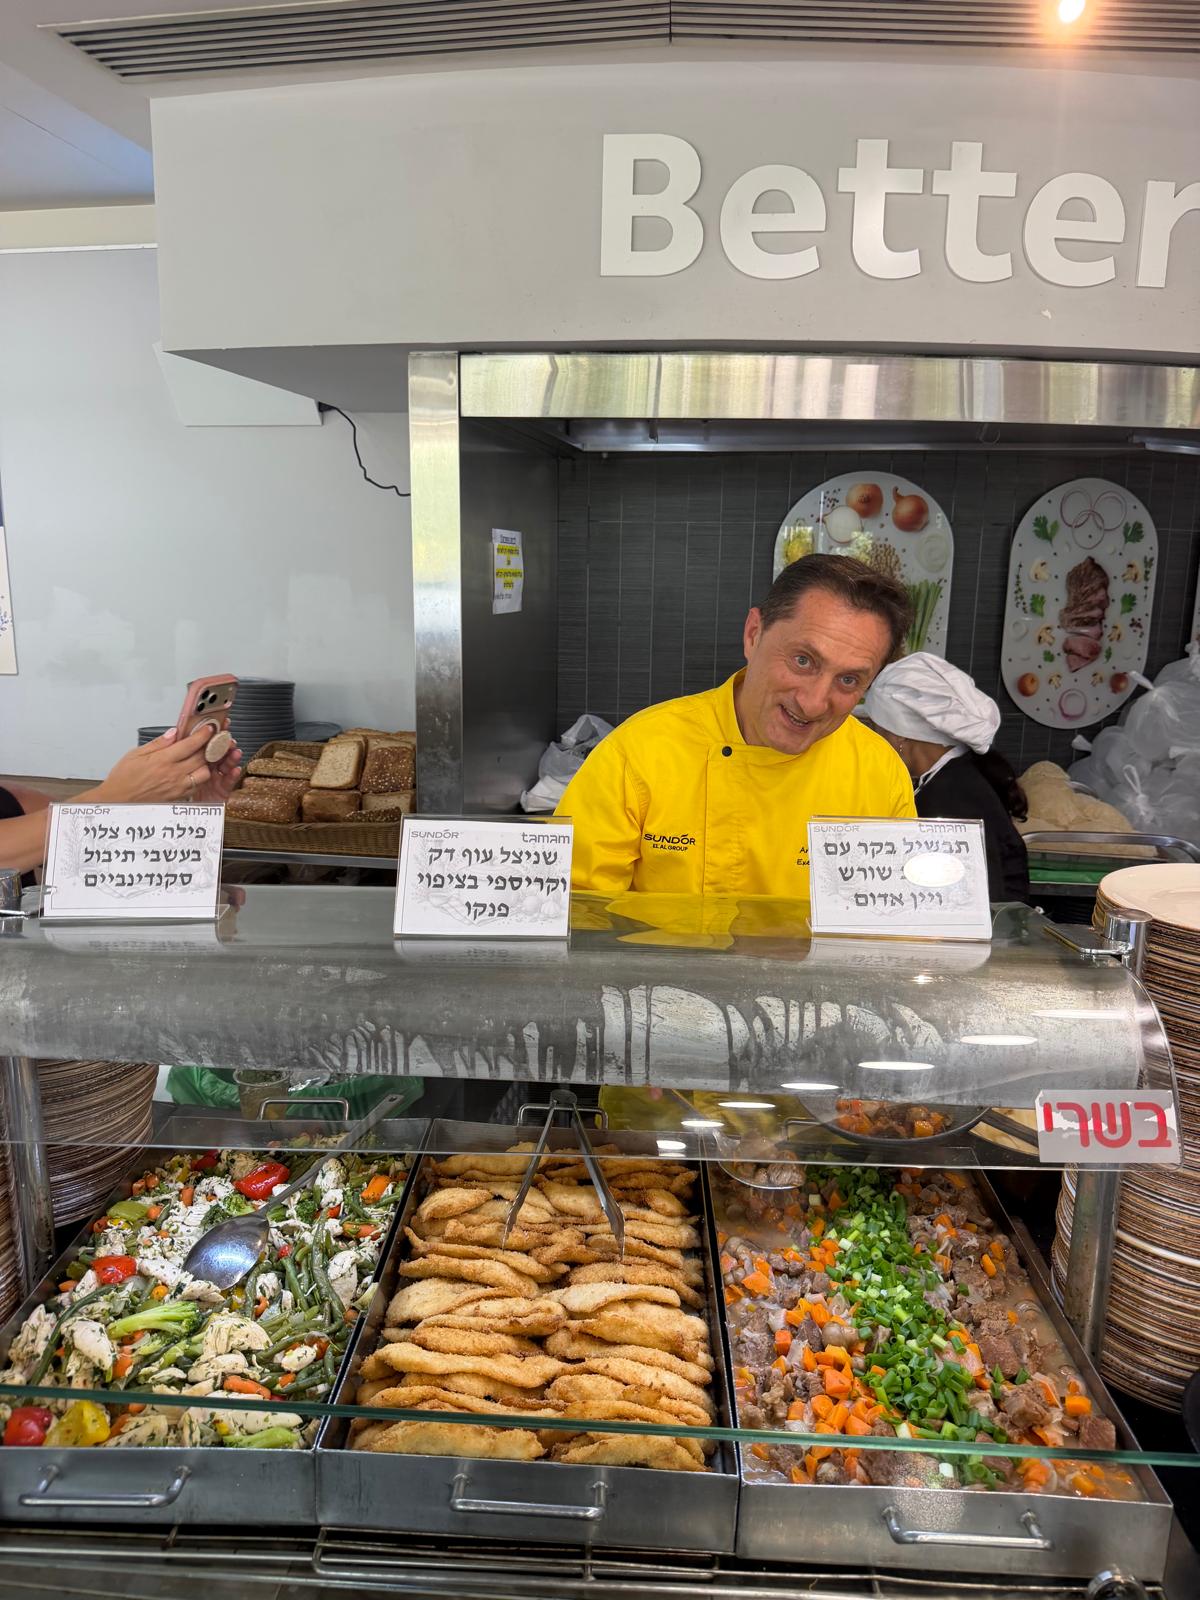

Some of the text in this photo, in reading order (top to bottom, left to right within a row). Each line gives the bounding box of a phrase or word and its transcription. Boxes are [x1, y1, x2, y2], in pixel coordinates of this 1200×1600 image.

[600, 133, 1200, 288] Better
[172, 805, 222, 816] tamam
[83, 823, 207, 842] פילה עוף צלוי
[918, 822, 967, 833] tamam
[521, 832, 571, 844] tamam
[84, 846, 202, 862] בעשבי תיבול
[428, 846, 558, 866] שניצל עוף דק
[824, 837, 970, 858] תבשיל בקר עם
[84, 872, 193, 889] סקנדינביים
[838, 866, 893, 881] שורש
[417, 872, 568, 896] וקריספי בציפוי
[910, 892, 943, 910] ויין
[465, 901, 510, 921] פנקו
[1043, 1101, 1172, 1149] בשרי
